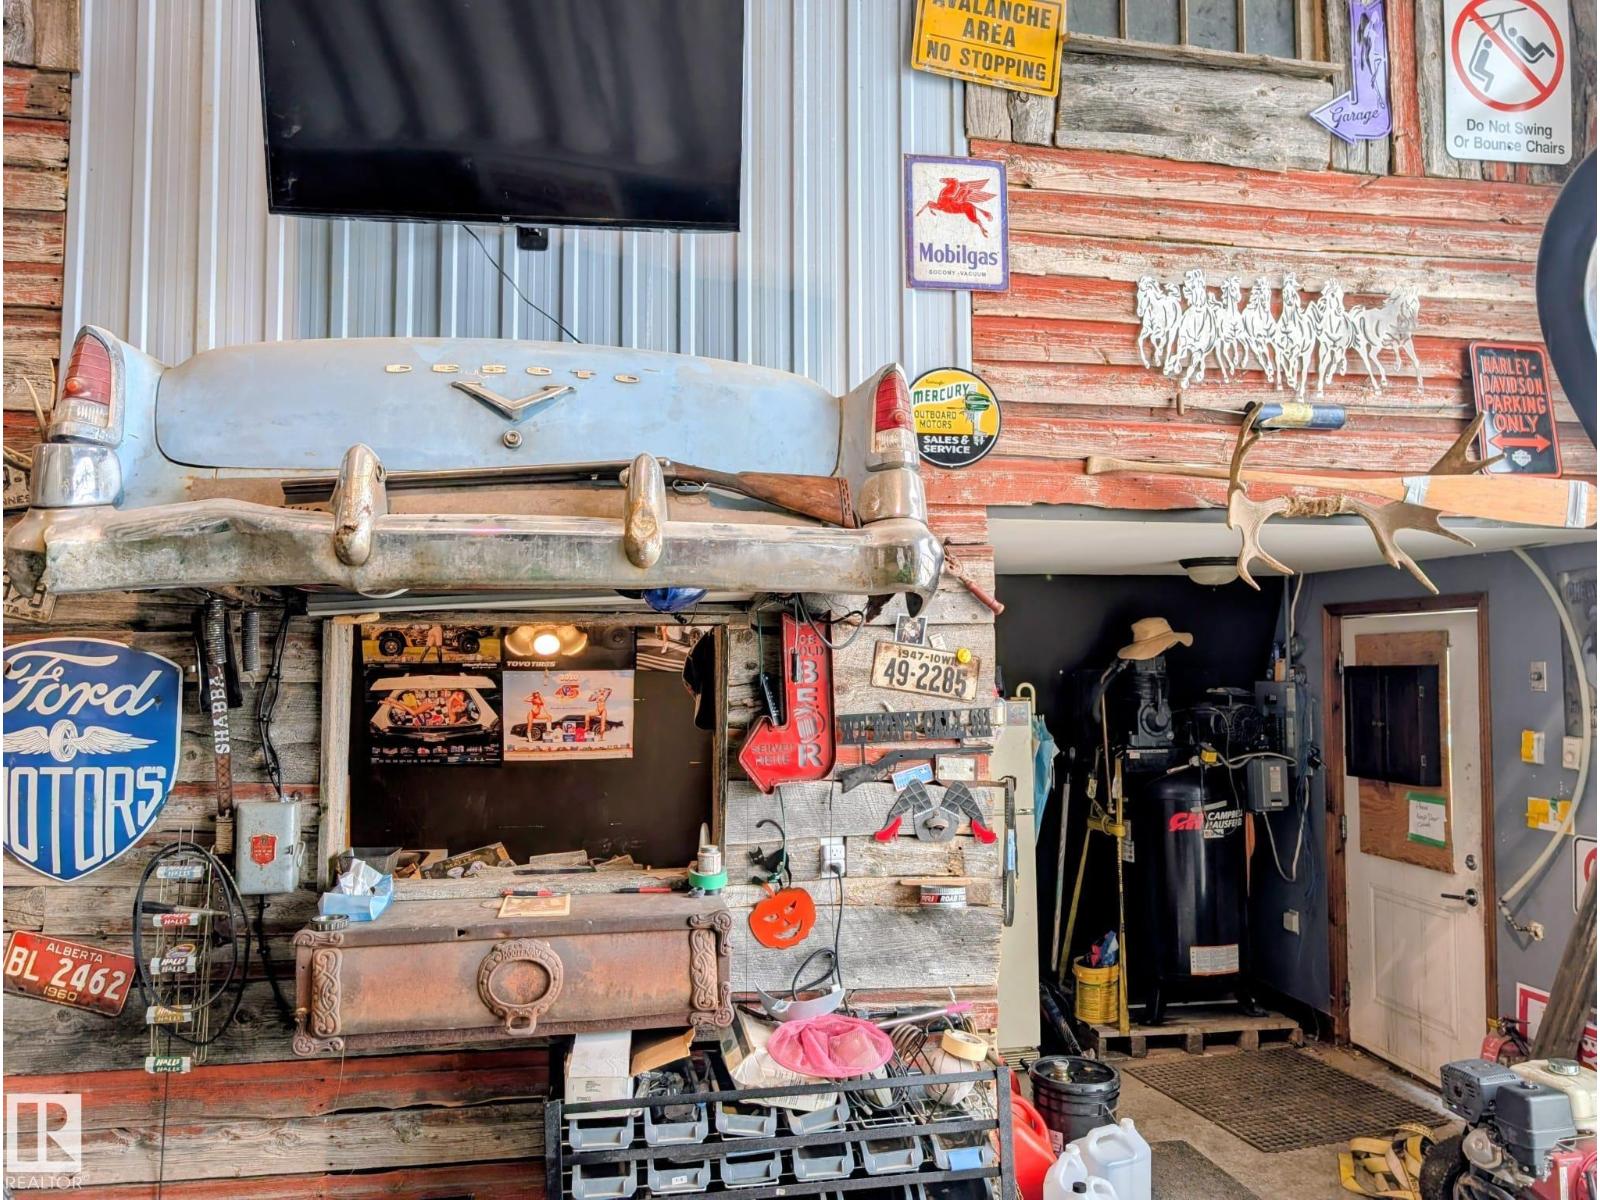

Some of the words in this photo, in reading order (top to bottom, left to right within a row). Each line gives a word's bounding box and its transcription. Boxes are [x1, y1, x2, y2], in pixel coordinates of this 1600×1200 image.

[962, 17, 1016, 48] AREA
[926, 39, 951, 62] NO
[959, 47, 1047, 82] STOPPING
[1330, 107, 1381, 128] Garage
[1466, 118, 1484, 131] Do
[1488, 119, 1511, 133] Not
[1514, 122, 1553, 139] Swing
[1453, 135, 1470, 148] Or
[1473, 136, 1522, 151] Bounce
[1525, 140, 1566, 155] Chairs
[919, 242, 999, 270] Mobilgas
[1480, 355, 1537, 374] HARLEY-
[1481, 374, 1544, 394] DAVIDSON
[913, 383, 970, 406] MERCURY
[914, 410, 957, 420] OUTBOARD
[1484, 395, 1547, 415] PARKING
[919, 420, 952, 430] MOTORS
[1494, 414, 1540, 433] ONLY
[923, 435, 959, 445] SALES
[960, 435, 970, 445] &
[923, 445, 971, 454] SERVICE
[3, 649, 164, 717] Ford
[883, 657, 968, 698] 49-2285
[46, 942, 103, 963] ALBERTA
[5, 945, 39, 981] BL
[51, 957, 127, 1001] 2462
[43, 985, 78, 1002] 1960
